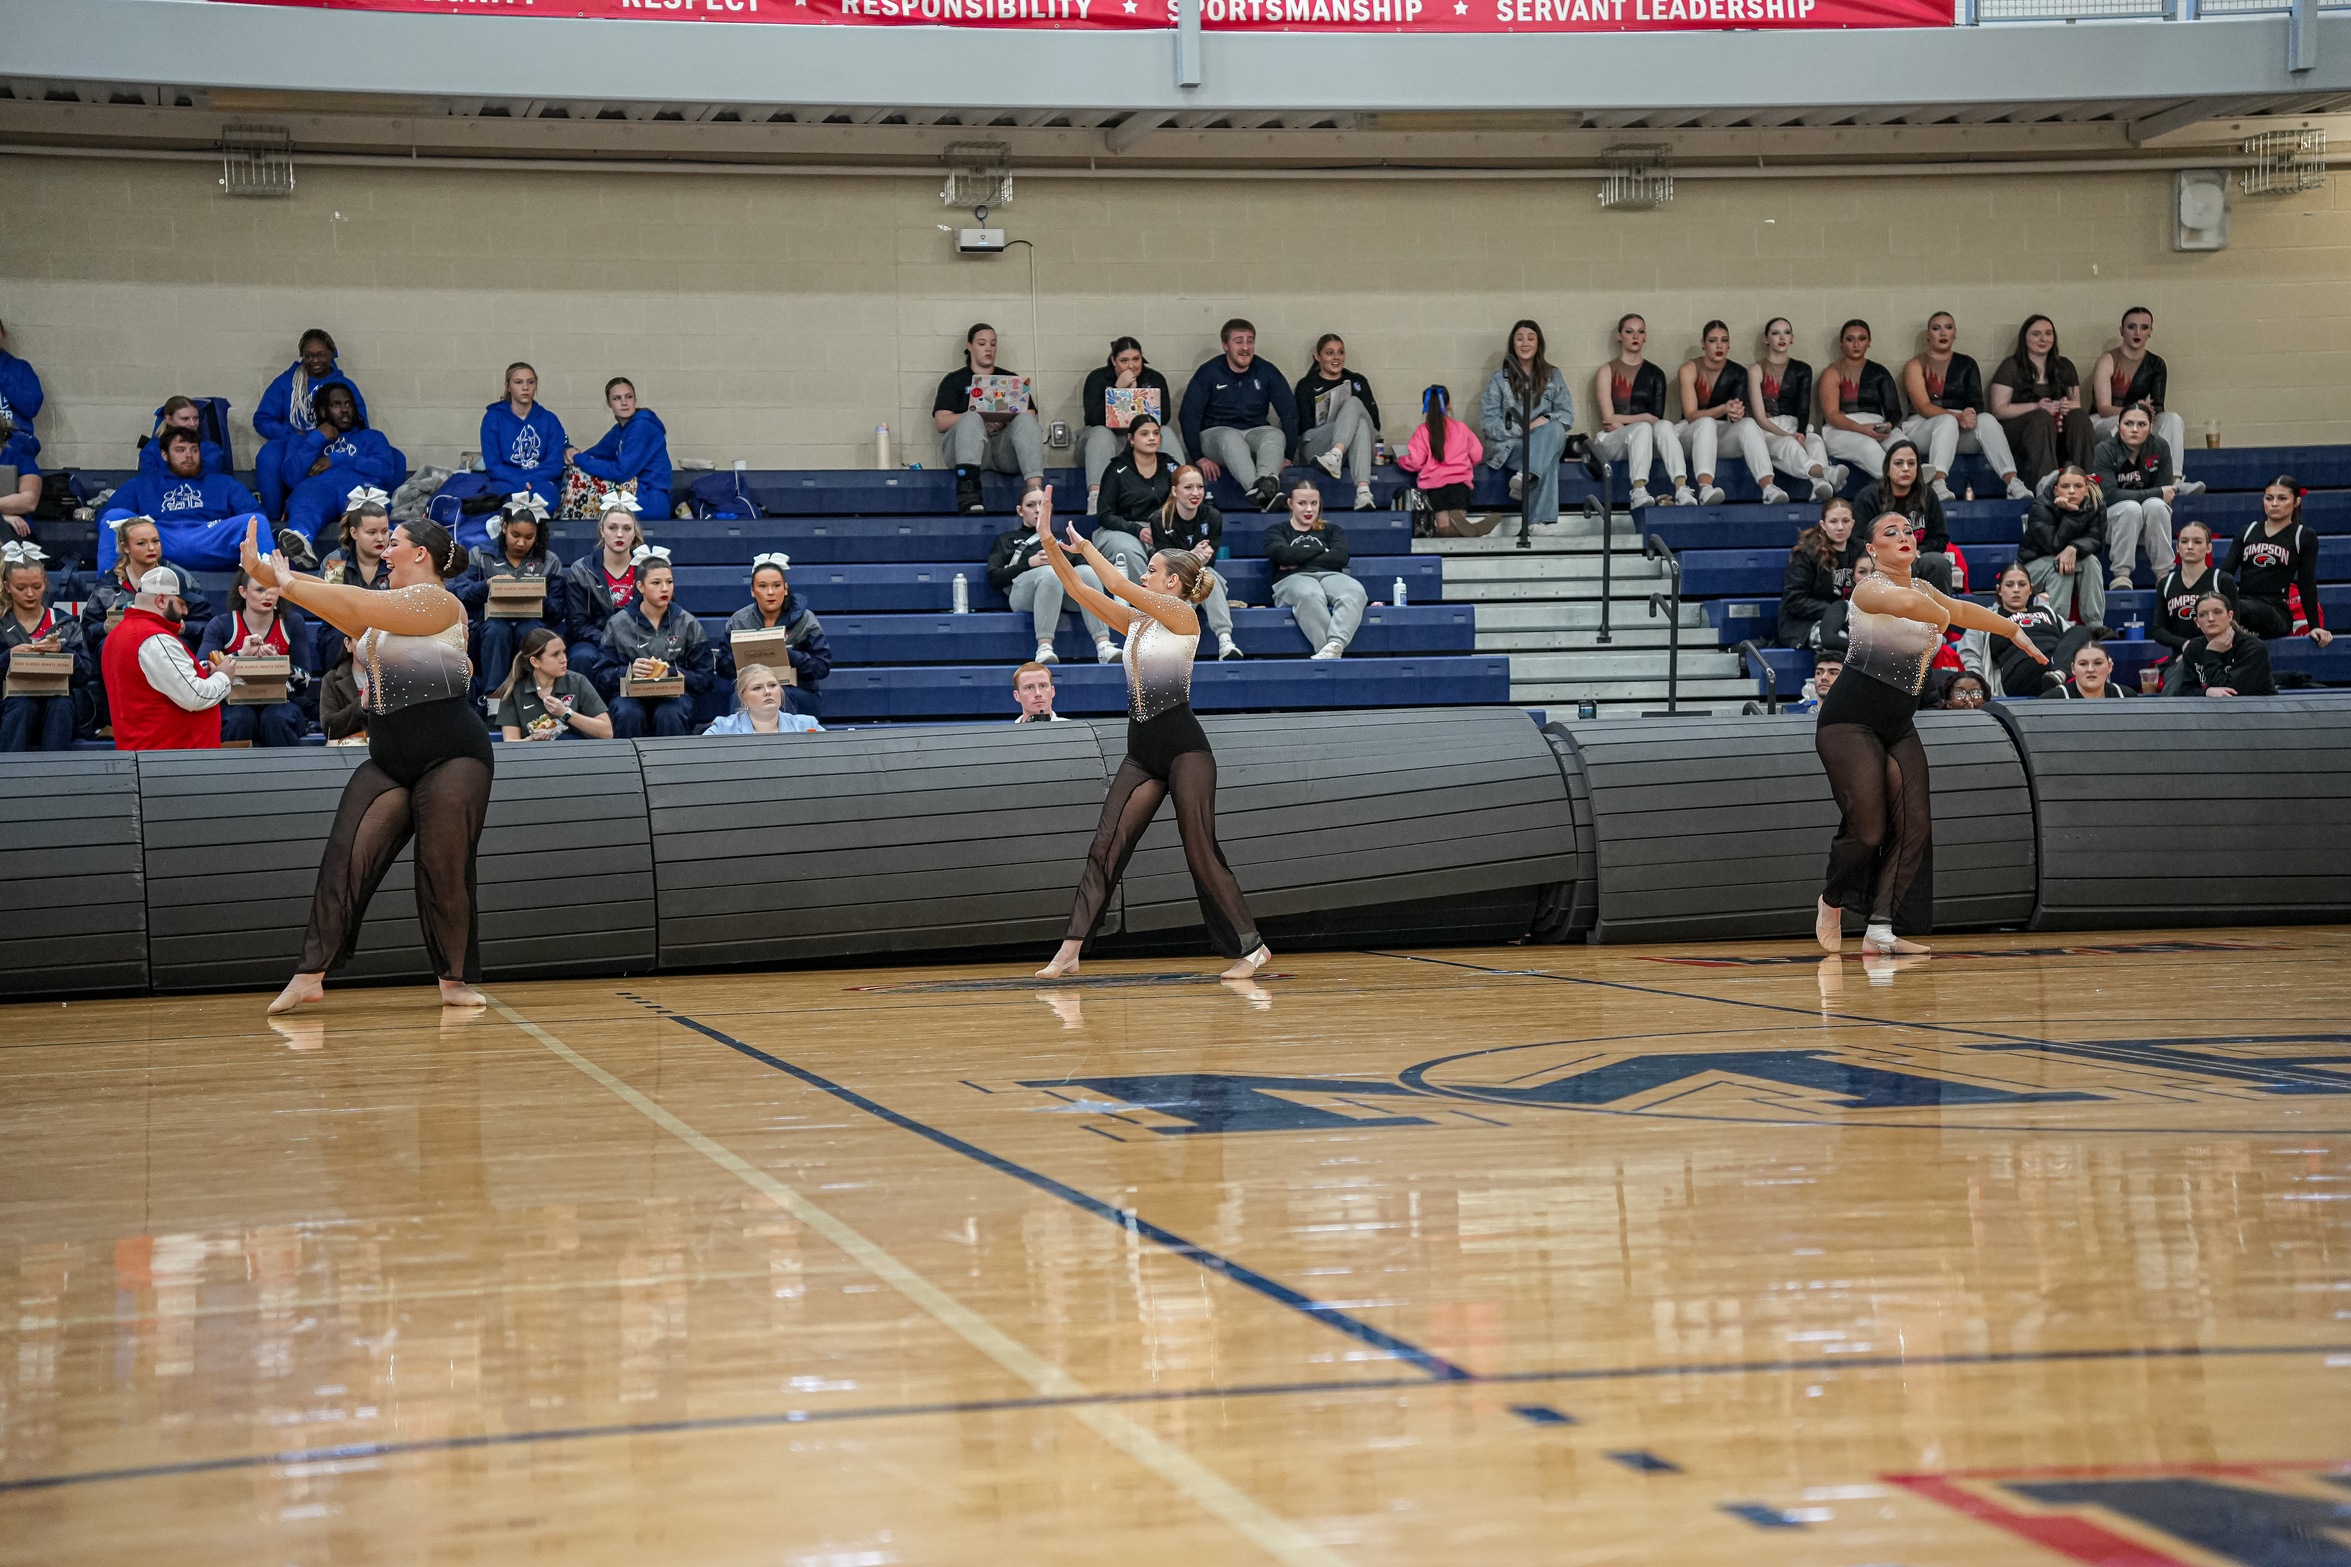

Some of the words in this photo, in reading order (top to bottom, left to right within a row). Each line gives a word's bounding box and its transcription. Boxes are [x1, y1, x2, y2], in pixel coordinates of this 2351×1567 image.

[841, 0, 1092, 19] RESPONSIBILITY
[1167, 0, 1423, 22] SORTSMANSHIP
[1496, 0, 1626, 22] SERVANT
[1636, 0, 1816, 21] LEADERSHIP
[2117, 470, 2142, 483] IMPS
[2242, 542, 2290, 566] SIMPSON
[2167, 594, 2200, 617] SIMPS
[2008, 611, 2053, 626] IMPSON
